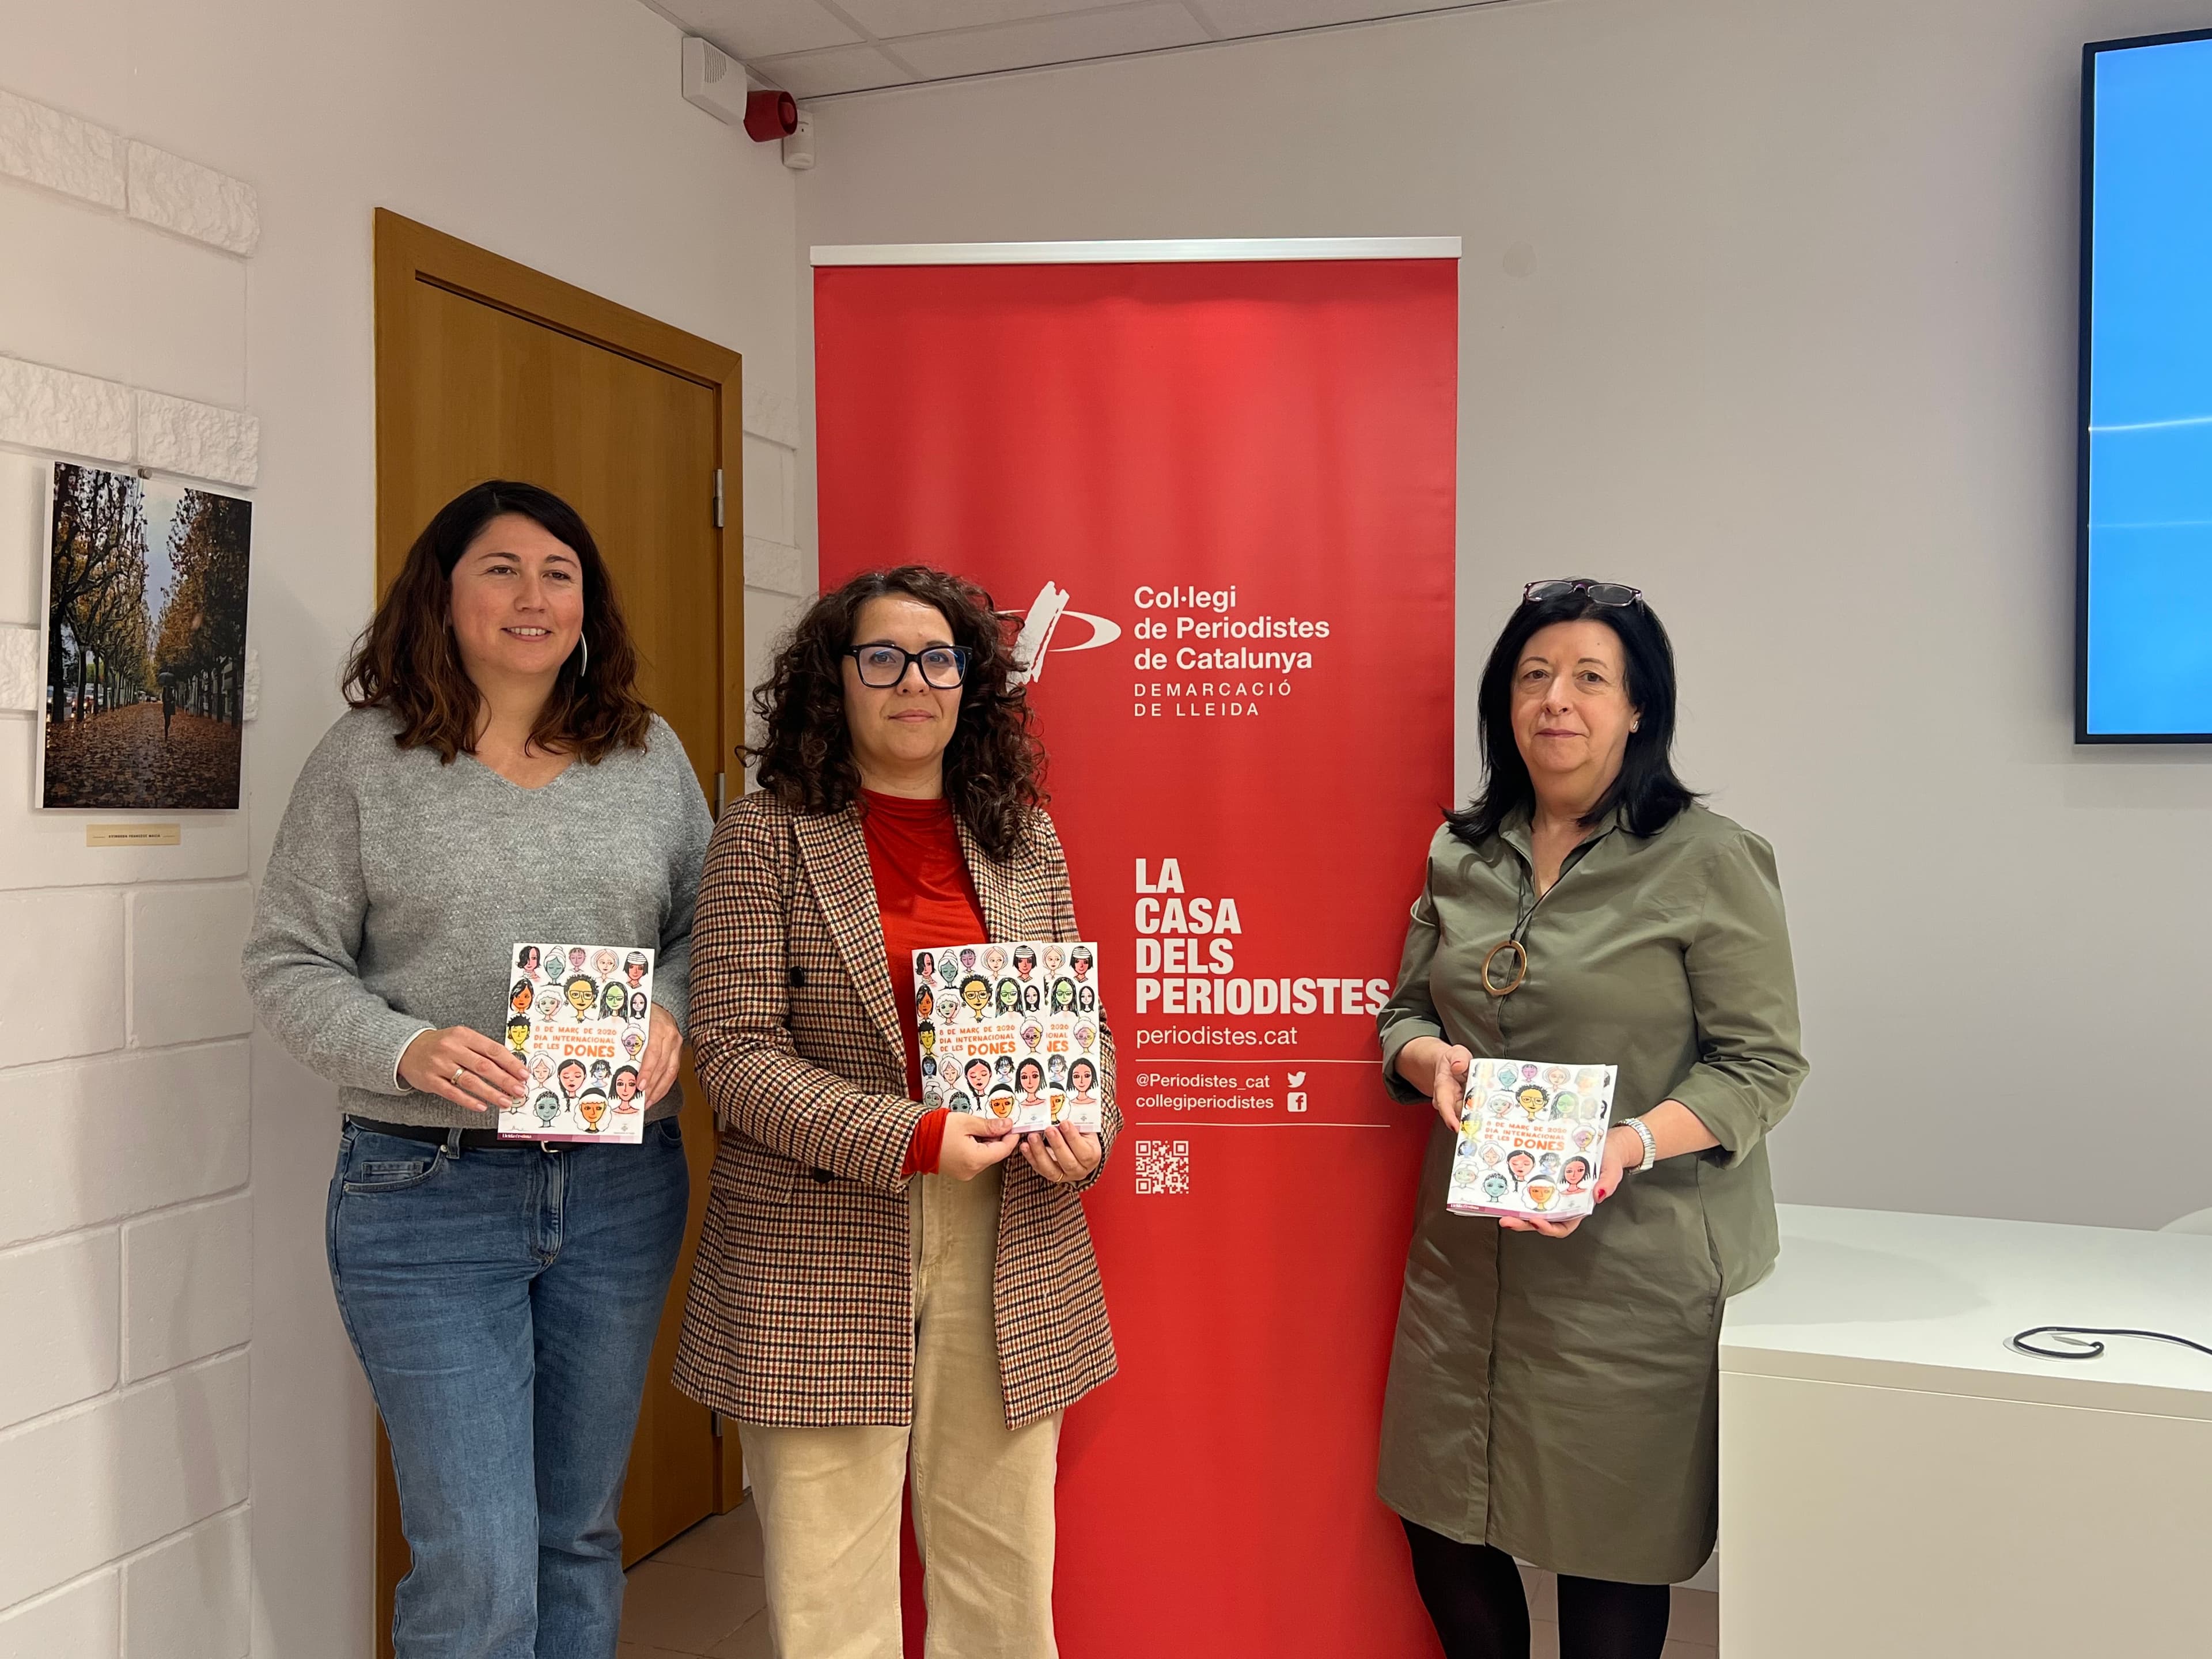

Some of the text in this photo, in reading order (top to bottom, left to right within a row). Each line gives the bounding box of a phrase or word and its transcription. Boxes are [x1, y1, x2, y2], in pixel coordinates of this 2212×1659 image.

[1134, 616, 1330, 639] de Periodistes
[1134, 647, 1312, 674] de Catalunya
[1134, 679, 1291, 696] DEMARCACIÓ
[1134, 702, 1259, 717] DE LLEIDA
[1135, 858, 1185, 893] LA
[1135, 897, 1242, 934] CASA
[1136, 938, 1234, 975] DELS
[1136, 978, 1389, 1016] PERIODISTES
[552, 1035, 615, 1044] INTERNACIONAL
[558, 1027, 579, 1035] MARÇ
[956, 1033, 1014, 1043] INTERNACIONAL
[1137, 1025, 1298, 1049] periodistes.cat
[564, 1044, 615, 1058] DONES
[967, 1041, 1016, 1056] DONES
[1136, 1073, 1271, 1091] @Periodistes_cat
[1136, 1094, 1274, 1111] collegiperiodistes
[1503, 1129, 1566, 1140] INTERNACIONAL
[1508, 1123, 1530, 1131] MARÇ
[1514, 1137, 1565, 1152] DONES
